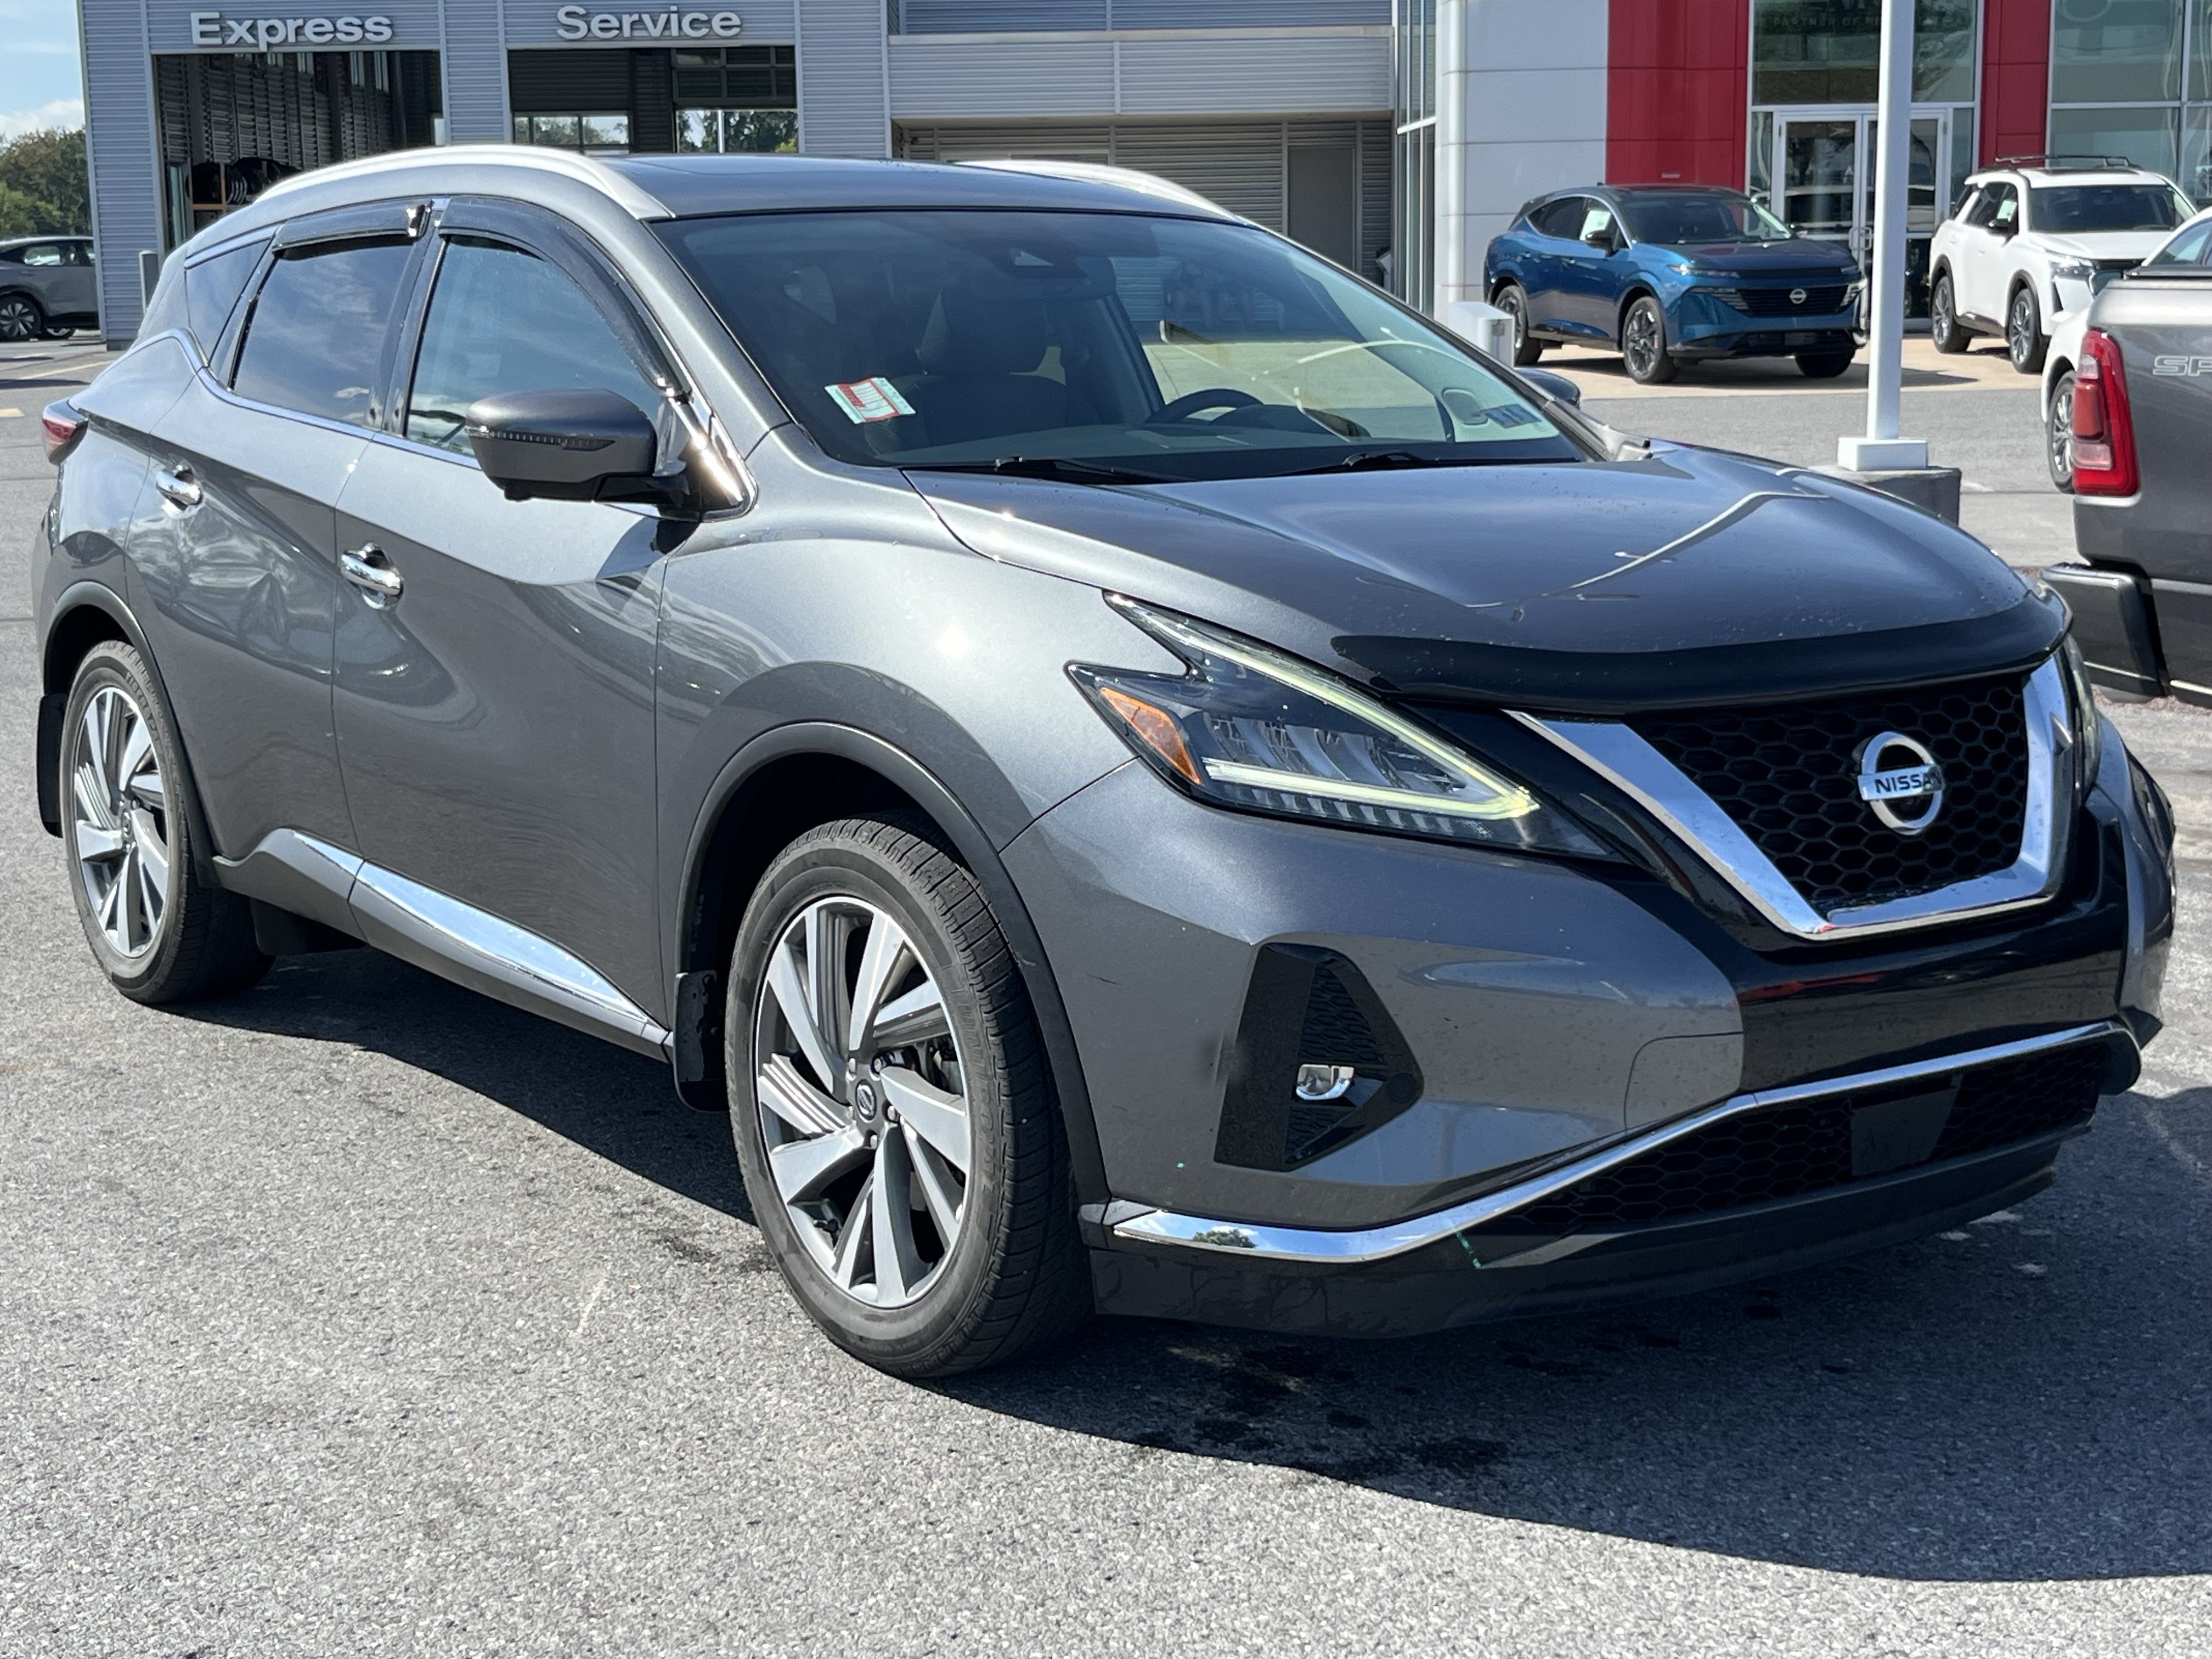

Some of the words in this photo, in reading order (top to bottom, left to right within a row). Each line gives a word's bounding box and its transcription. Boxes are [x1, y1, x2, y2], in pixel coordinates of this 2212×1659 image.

[190, 12, 393, 52] Express
[556, 5, 741, 40] Service
[1875, 771, 1943, 793] NISSAN
